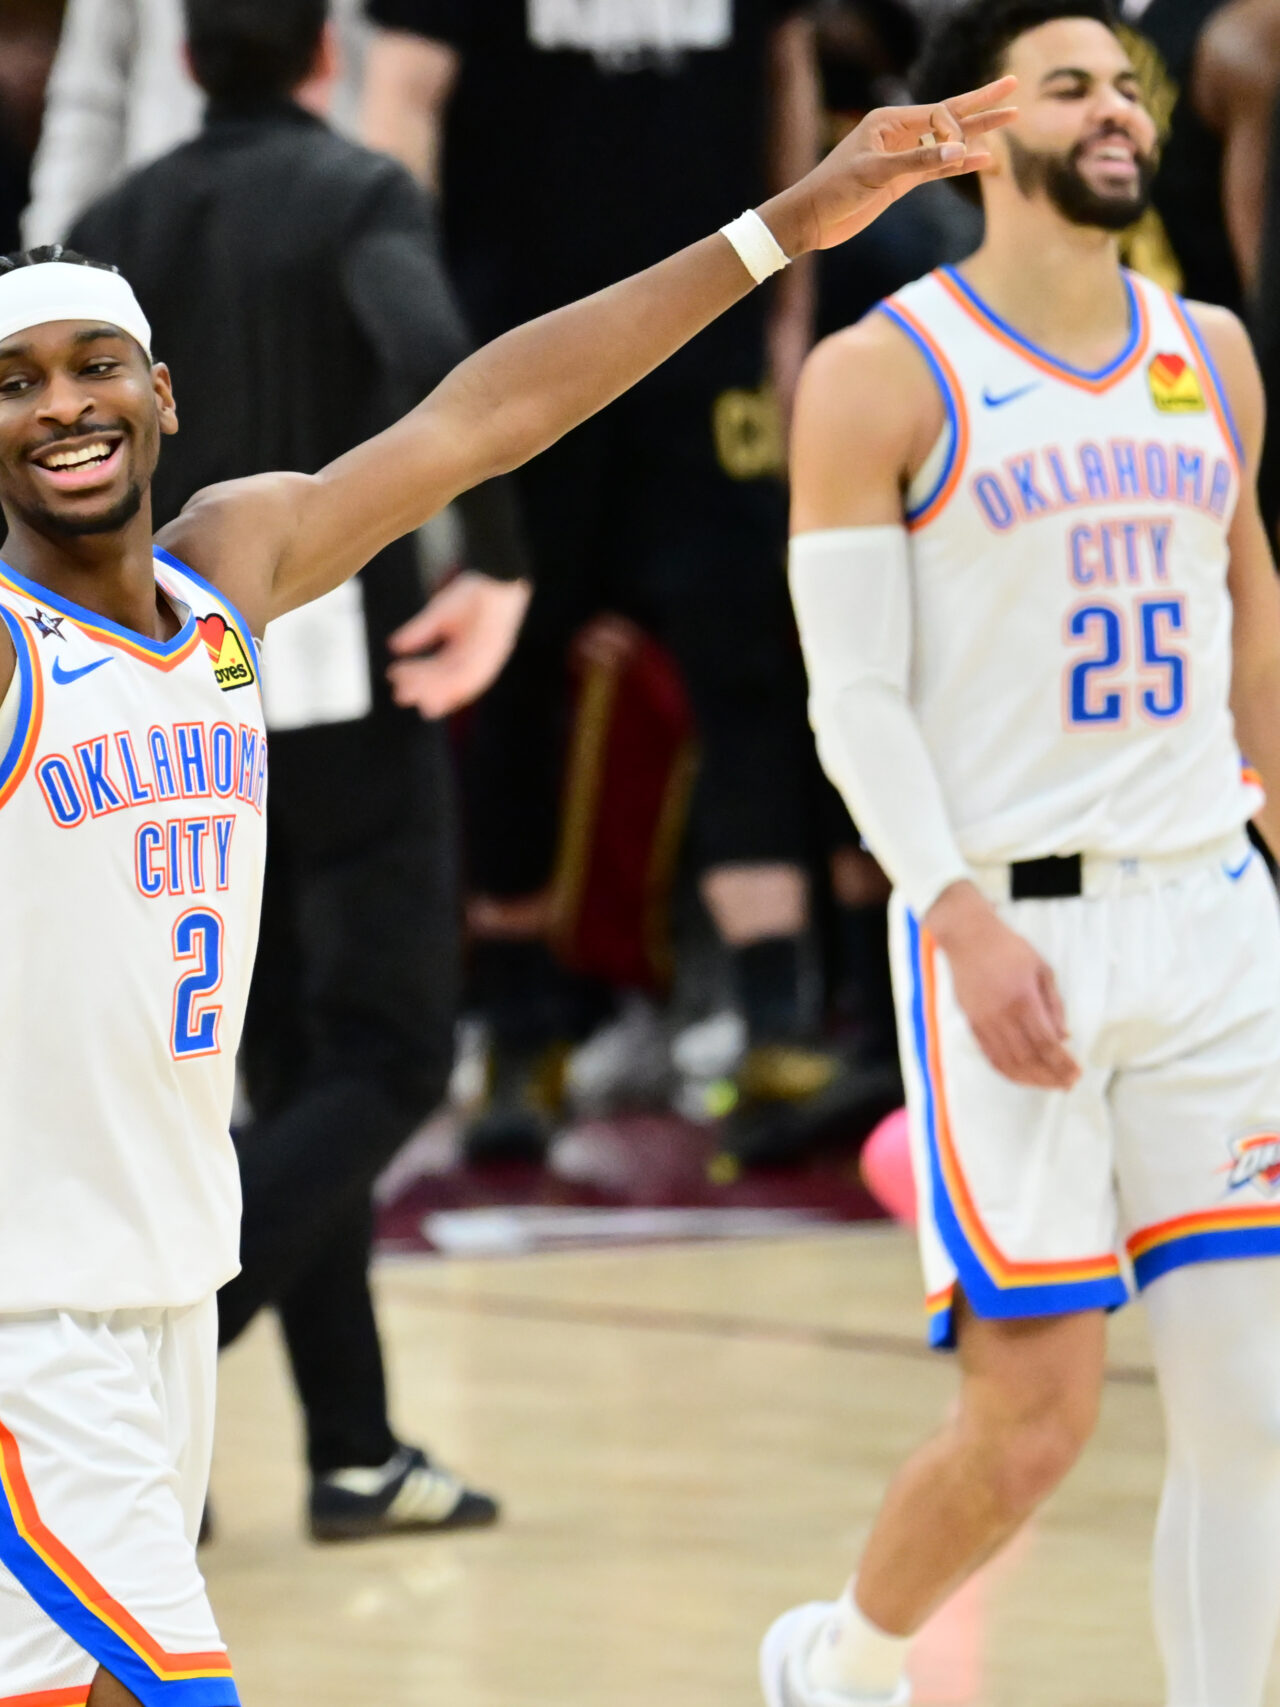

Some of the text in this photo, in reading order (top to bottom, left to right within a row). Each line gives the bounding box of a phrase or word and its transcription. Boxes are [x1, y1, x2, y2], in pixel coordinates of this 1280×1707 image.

[971, 437, 1234, 535] OKLAHOMA
[1066, 517, 1174, 587] CITY
[214, 663, 247, 683] oves
[1062, 593, 1190, 734] 25
[35, 722, 268, 829] OKLAHOMA
[135, 815, 236, 898] CITY
[170, 906, 224, 1061] 2
